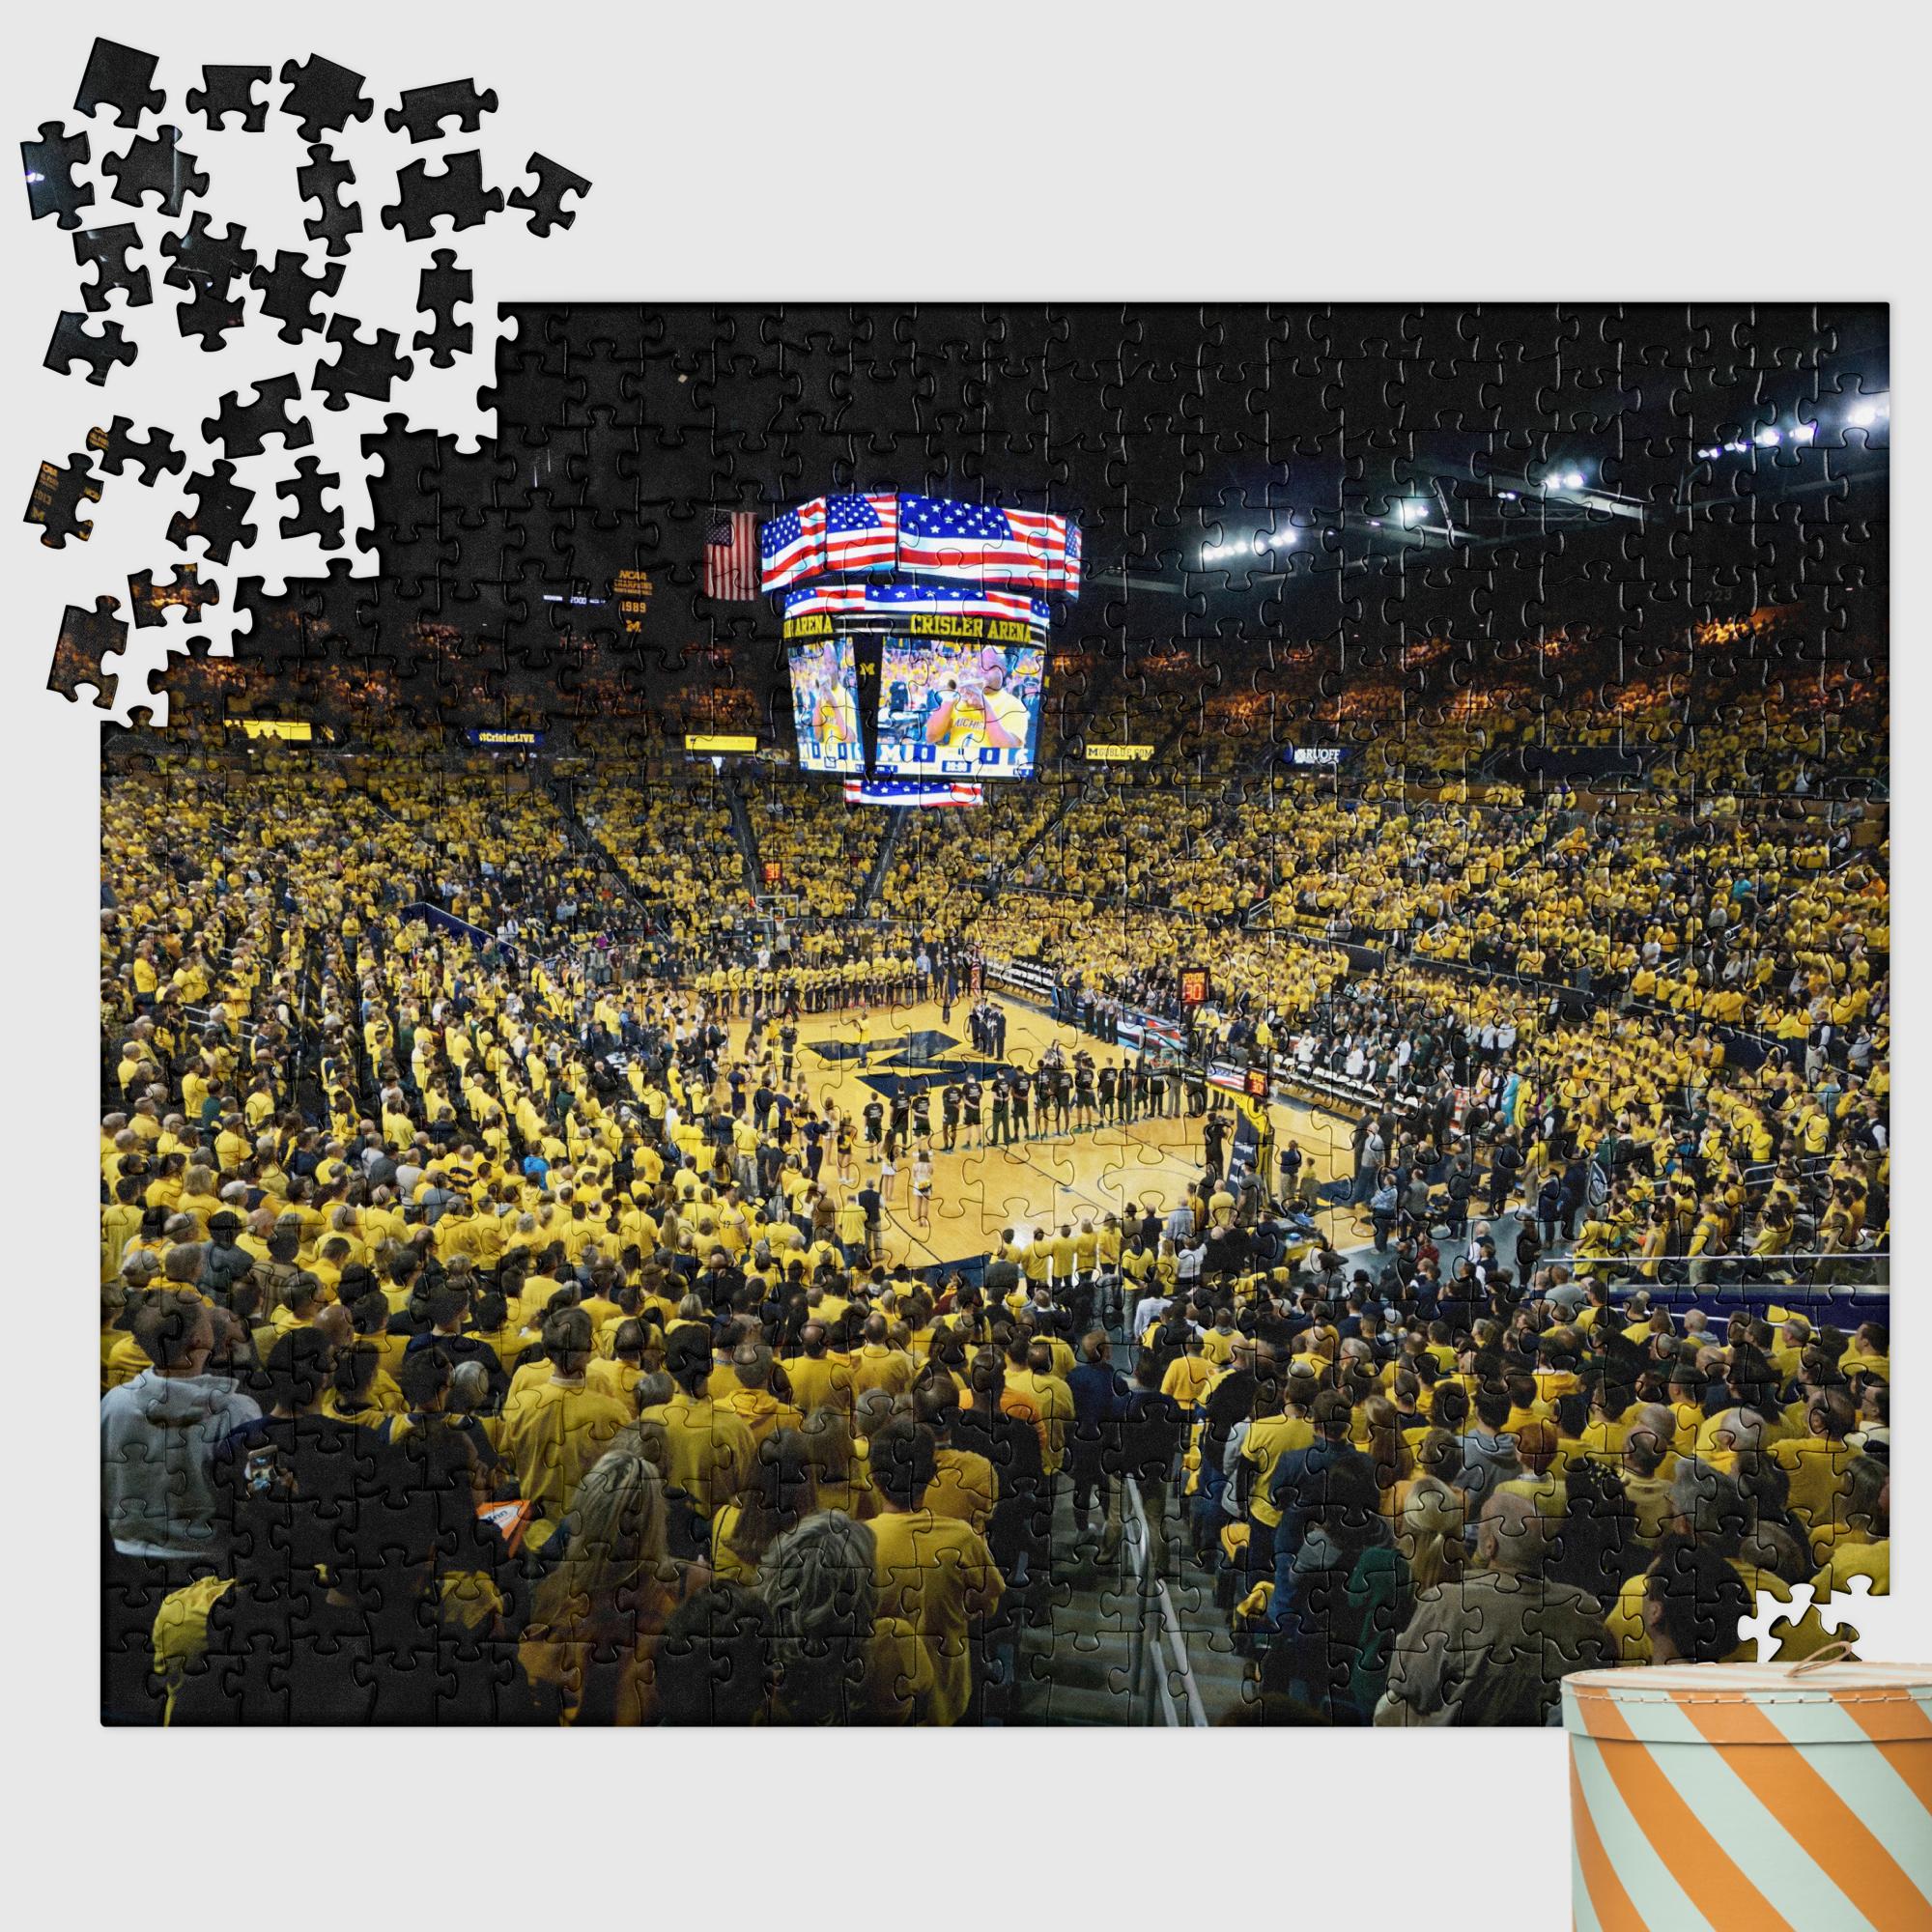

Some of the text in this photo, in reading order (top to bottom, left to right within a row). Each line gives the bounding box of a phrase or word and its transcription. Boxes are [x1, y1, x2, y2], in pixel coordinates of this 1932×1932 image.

[621, 601, 647, 613] 1989
[795, 614, 834, 637] ARENA
[910, 614, 1032, 643] CRISLER ARENA
[860, 663, 876, 675] M
[1306, 749, 1341, 760] RUOFF
